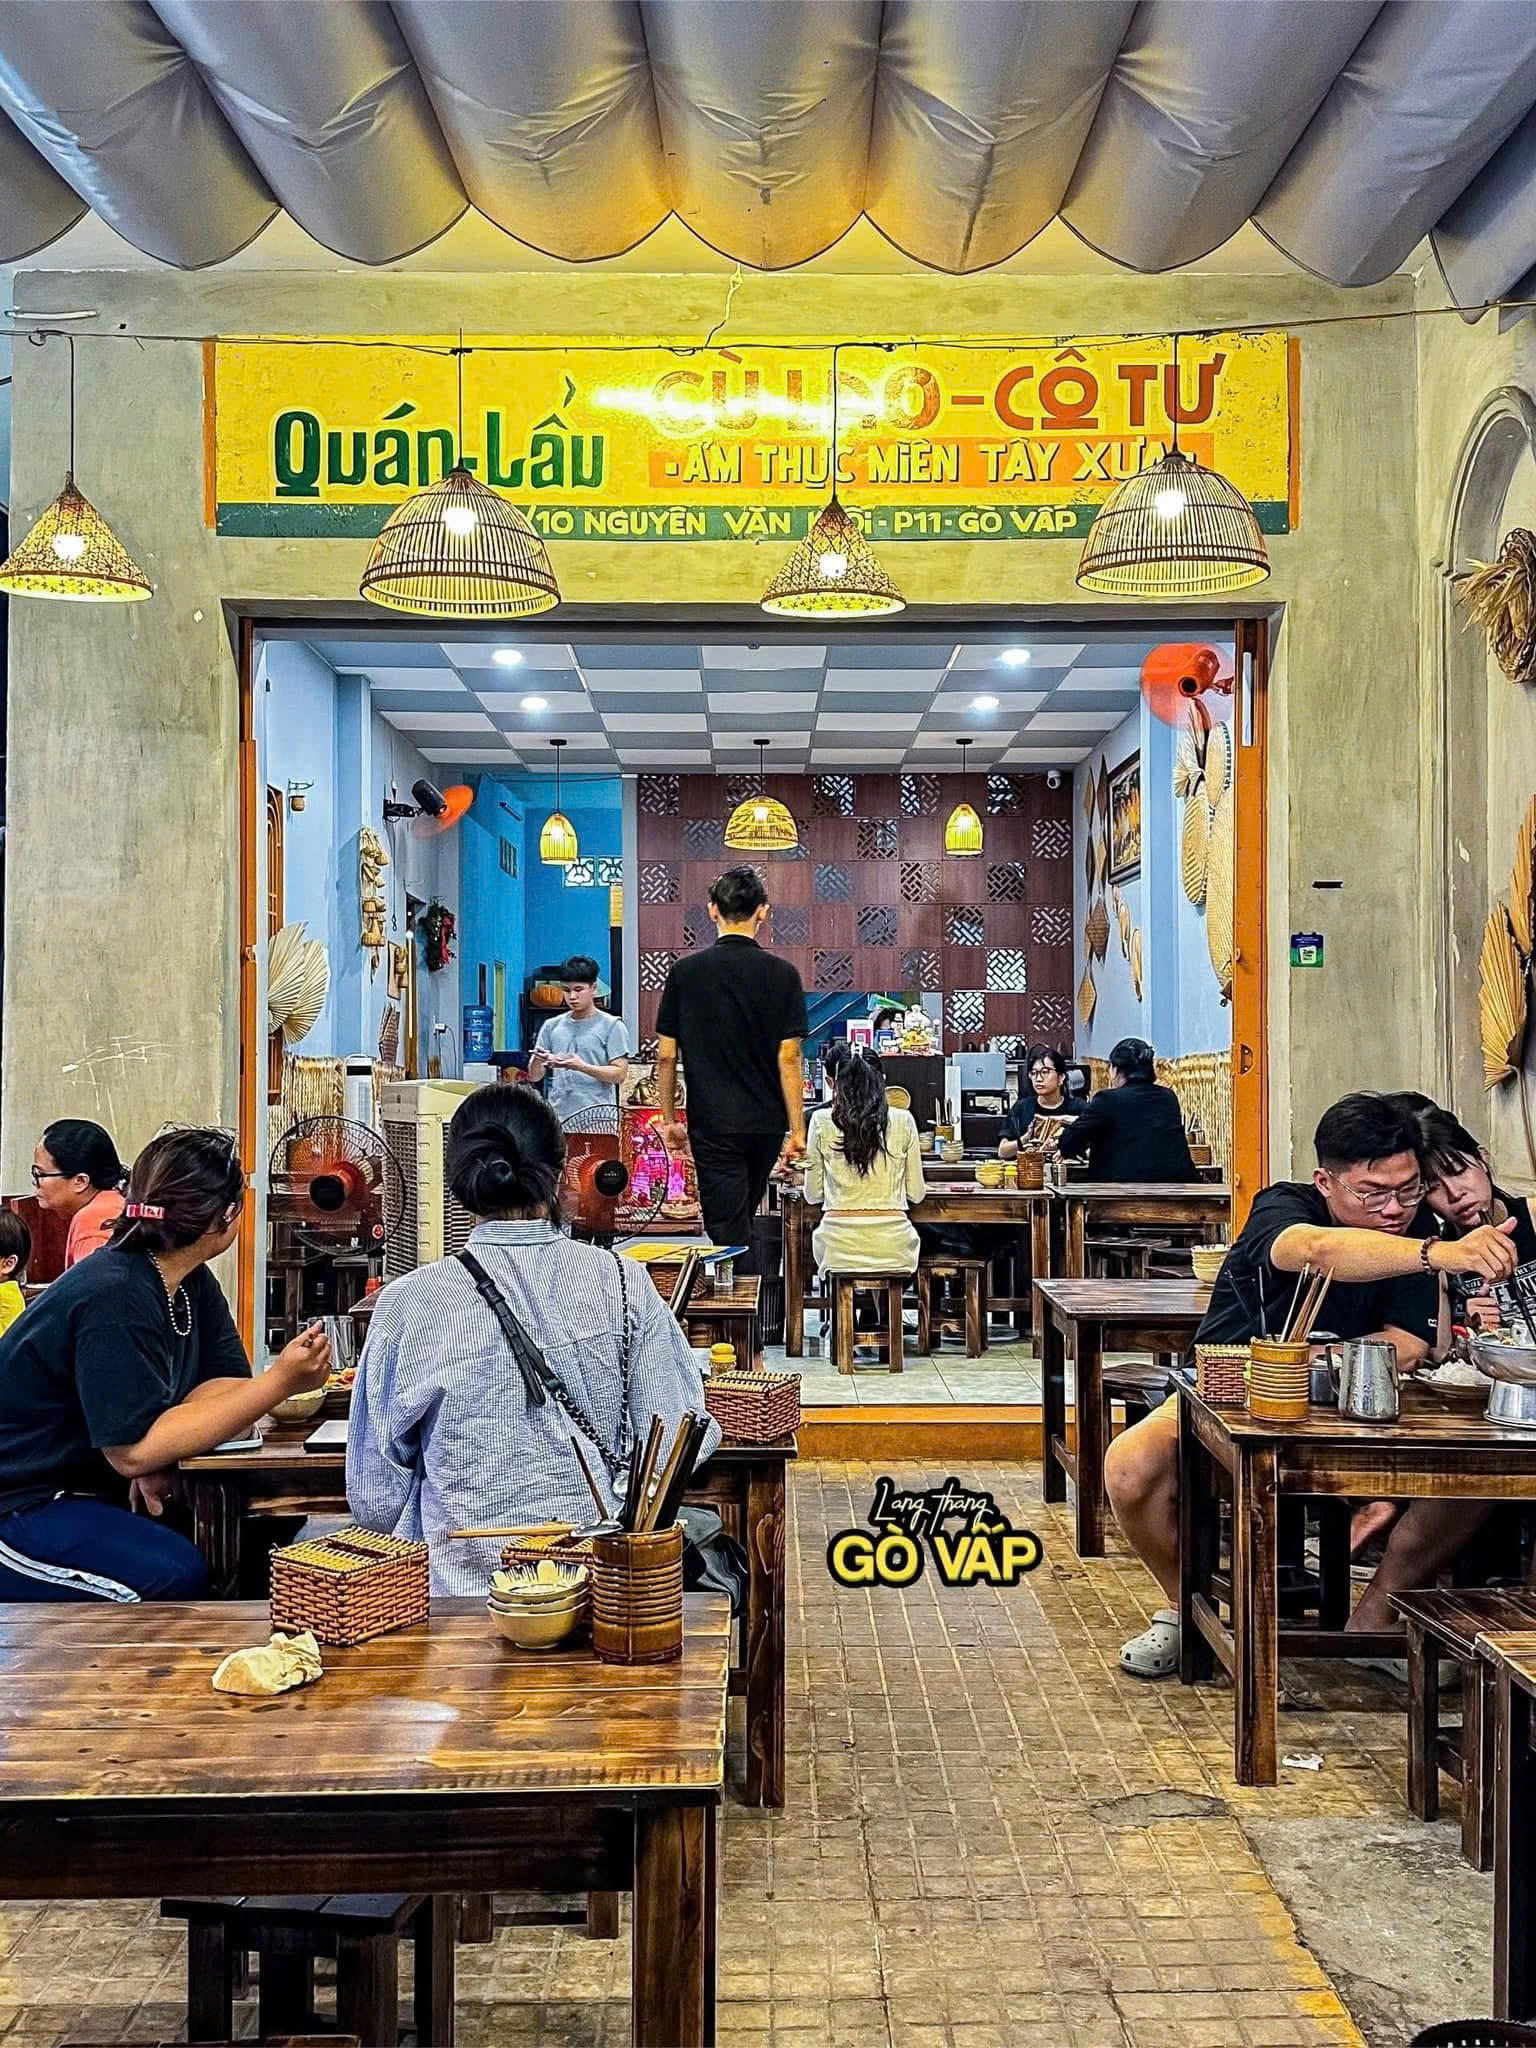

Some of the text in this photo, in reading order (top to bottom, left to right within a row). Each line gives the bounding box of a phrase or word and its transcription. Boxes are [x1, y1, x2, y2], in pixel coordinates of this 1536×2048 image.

[1118, 353, 1227, 427] TƯ
[979, 436, 1061, 482] TÂY
[723, 504, 792, 535] VĂN
